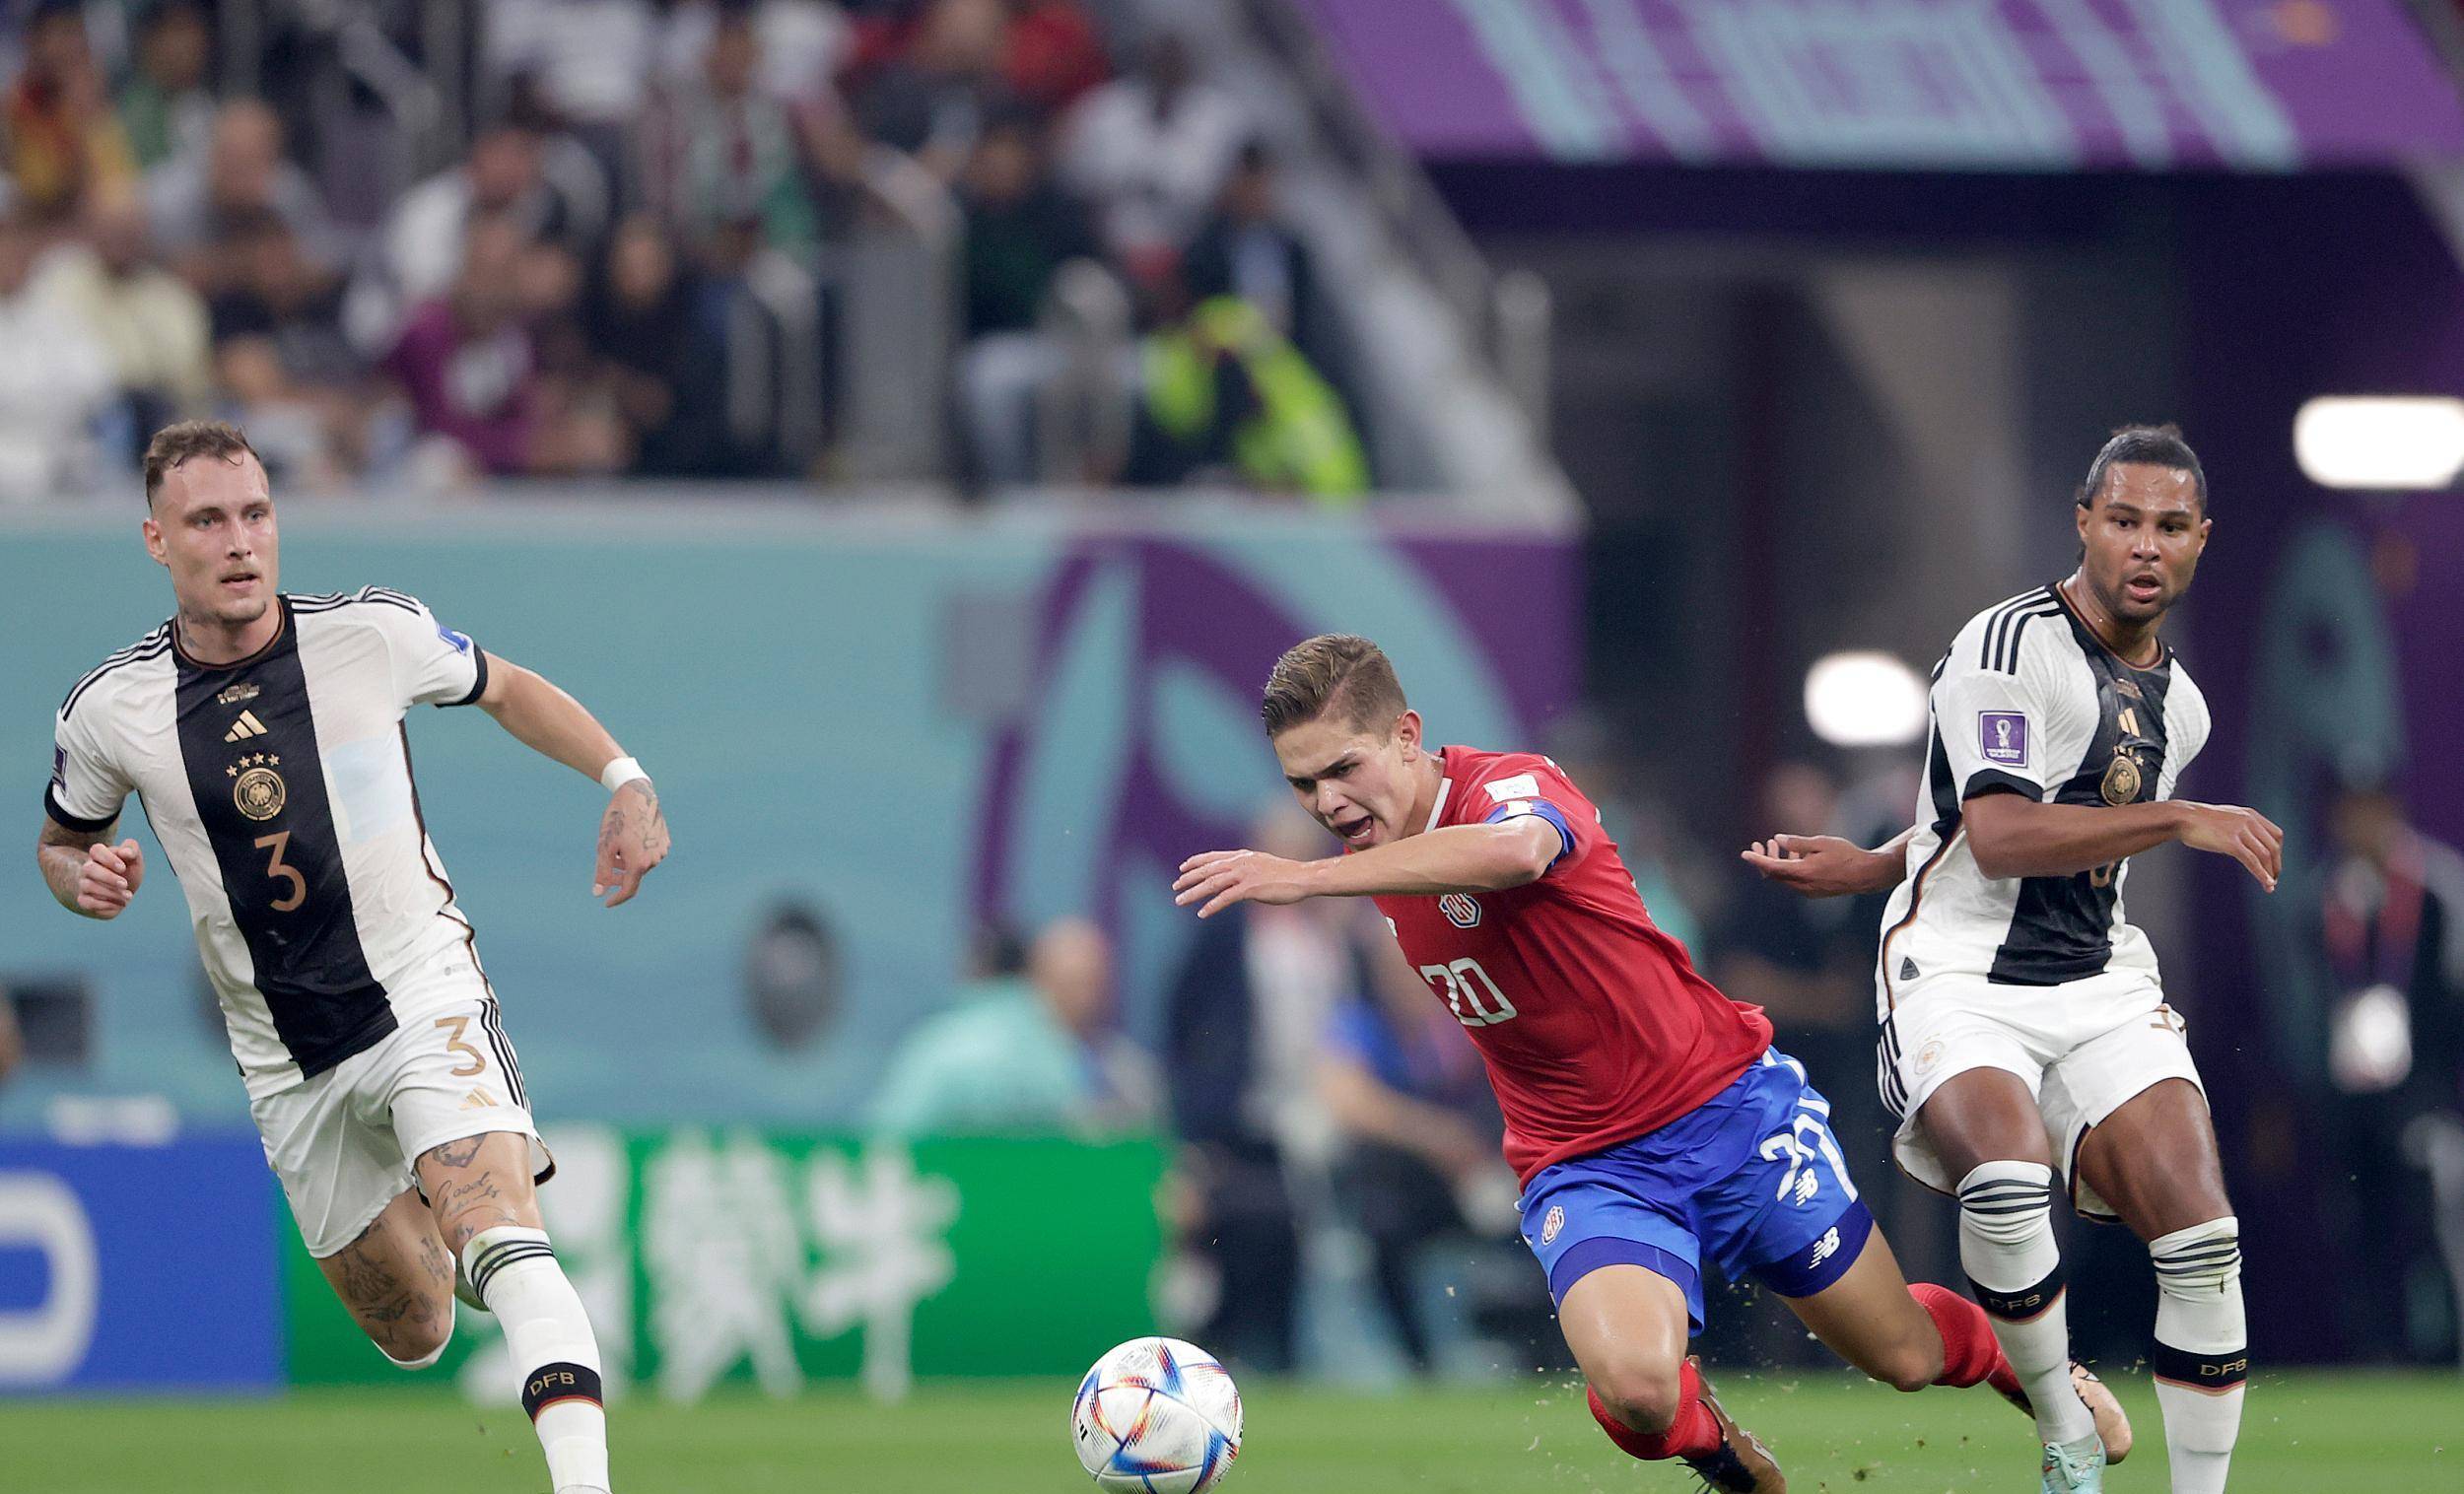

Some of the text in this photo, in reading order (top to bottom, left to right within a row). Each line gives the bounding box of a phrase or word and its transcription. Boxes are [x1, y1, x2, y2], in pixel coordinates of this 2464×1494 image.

[254, 831, 306, 912] 3
[1419, 957, 1518, 1027] 20
[435, 1016, 486, 1076] 3
[528, 1371, 576, 1396] DFB
[2200, 1358, 2247, 1376] DFB
